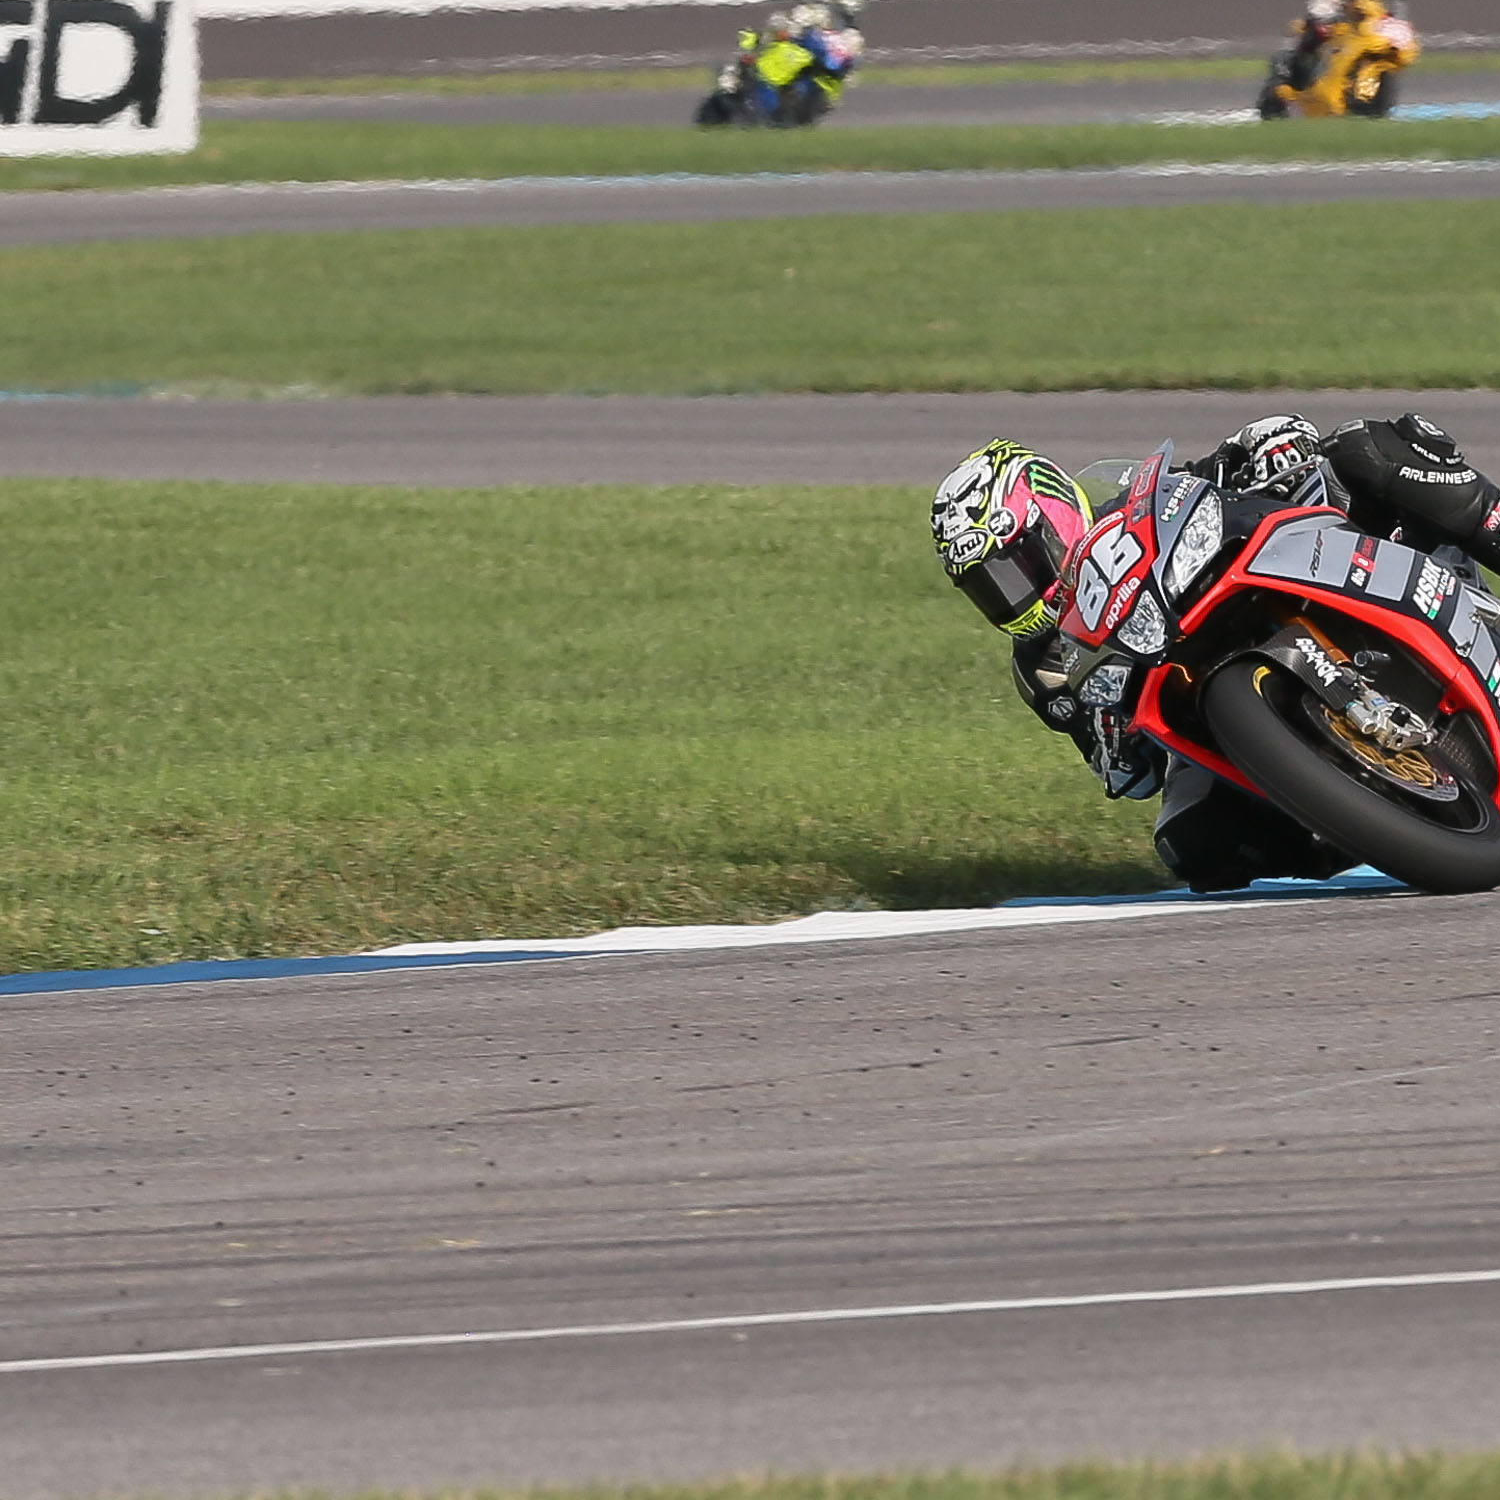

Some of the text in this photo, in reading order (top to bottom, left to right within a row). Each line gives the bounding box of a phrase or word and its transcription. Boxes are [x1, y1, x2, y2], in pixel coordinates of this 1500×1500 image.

[949, 534, 983, 561] Arai
[1076, 521, 1145, 632] 86
[1104, 576, 1141, 631] aprilia
[1413, 557, 1444, 614] HSBK
